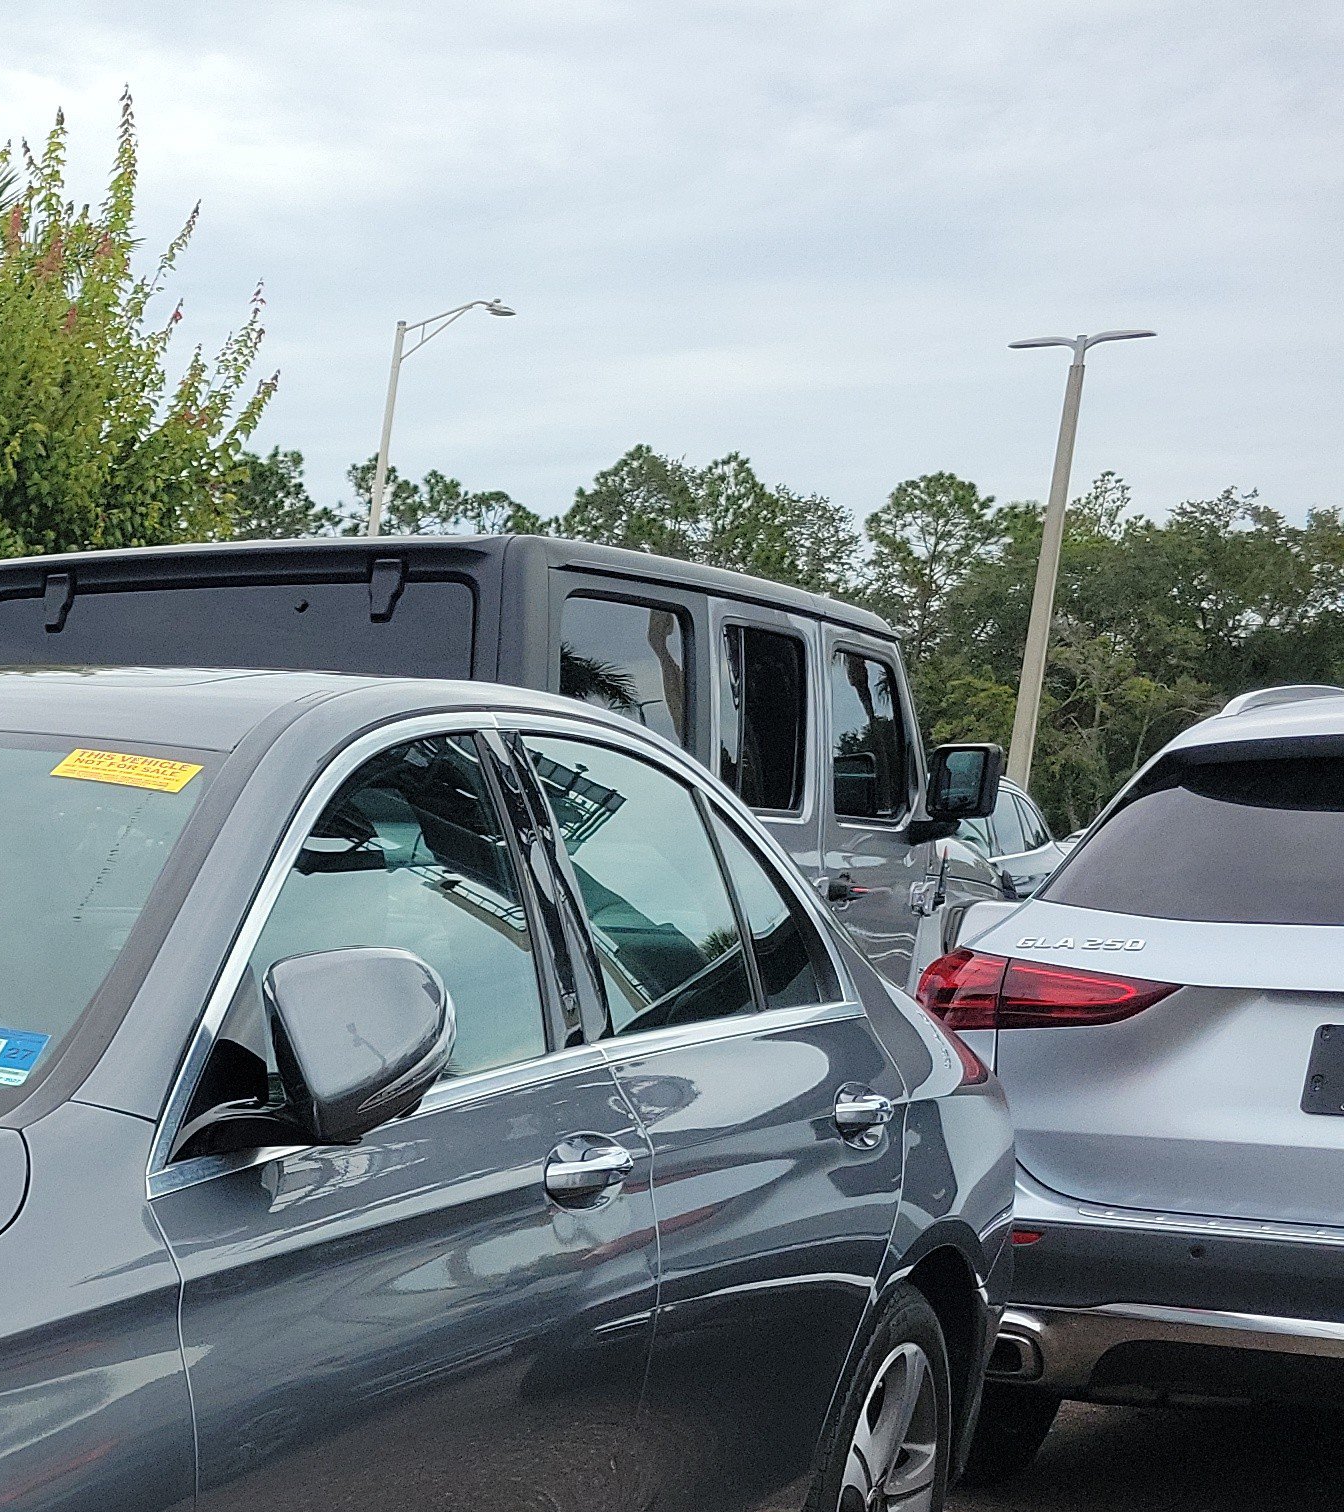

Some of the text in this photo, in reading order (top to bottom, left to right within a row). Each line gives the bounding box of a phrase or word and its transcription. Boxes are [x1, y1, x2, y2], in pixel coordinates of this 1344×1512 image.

[74, 757, 103, 766] NOT
[107, 761, 137, 771] FOR
[143, 766, 181, 778] SALE
[78, 750, 192, 772] THIS VEHICLE
[1015, 936, 1146, 952] GLA 250
[4, 1047, 35, 1061] 27
